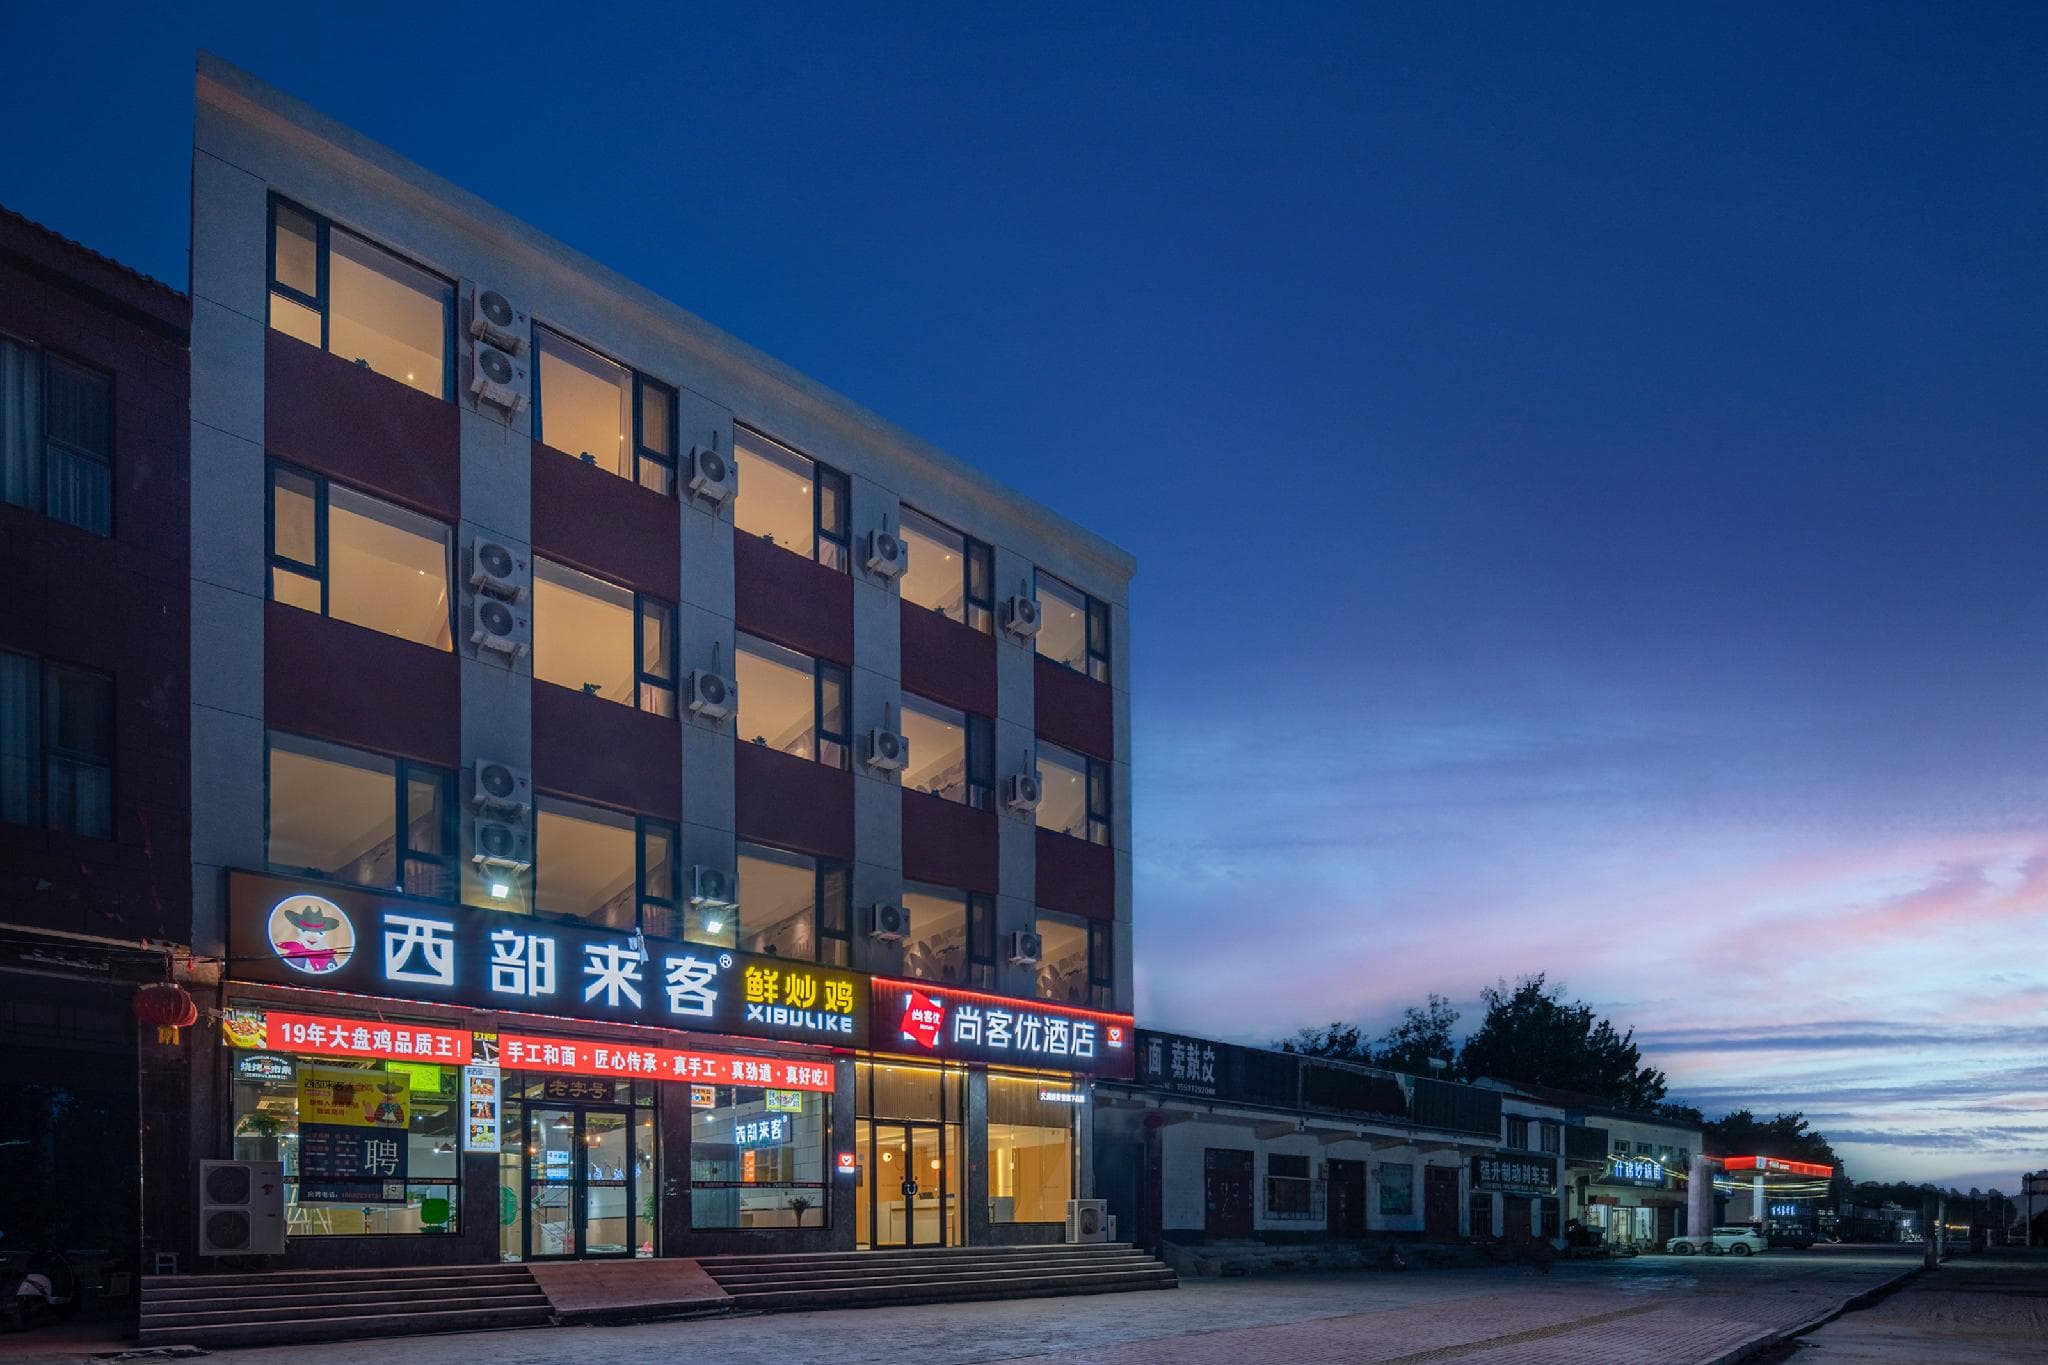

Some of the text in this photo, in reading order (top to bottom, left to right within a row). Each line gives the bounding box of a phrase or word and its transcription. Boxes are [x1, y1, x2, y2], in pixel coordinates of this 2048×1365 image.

[383, 913, 719, 1018] 西部来客
[745, 966, 854, 1014] 鲜炒鸡
[747, 1002, 853, 1033] XIBULIKE
[911, 1008, 940, 1025] 尚客优
[953, 1005, 1095, 1059] 尚客优酒店
[280, 1022, 463, 1058] 19年大盘鸡品质王!
[548, 1079, 607, 1100] 老字号
[363, 1139, 401, 1177] 聘
